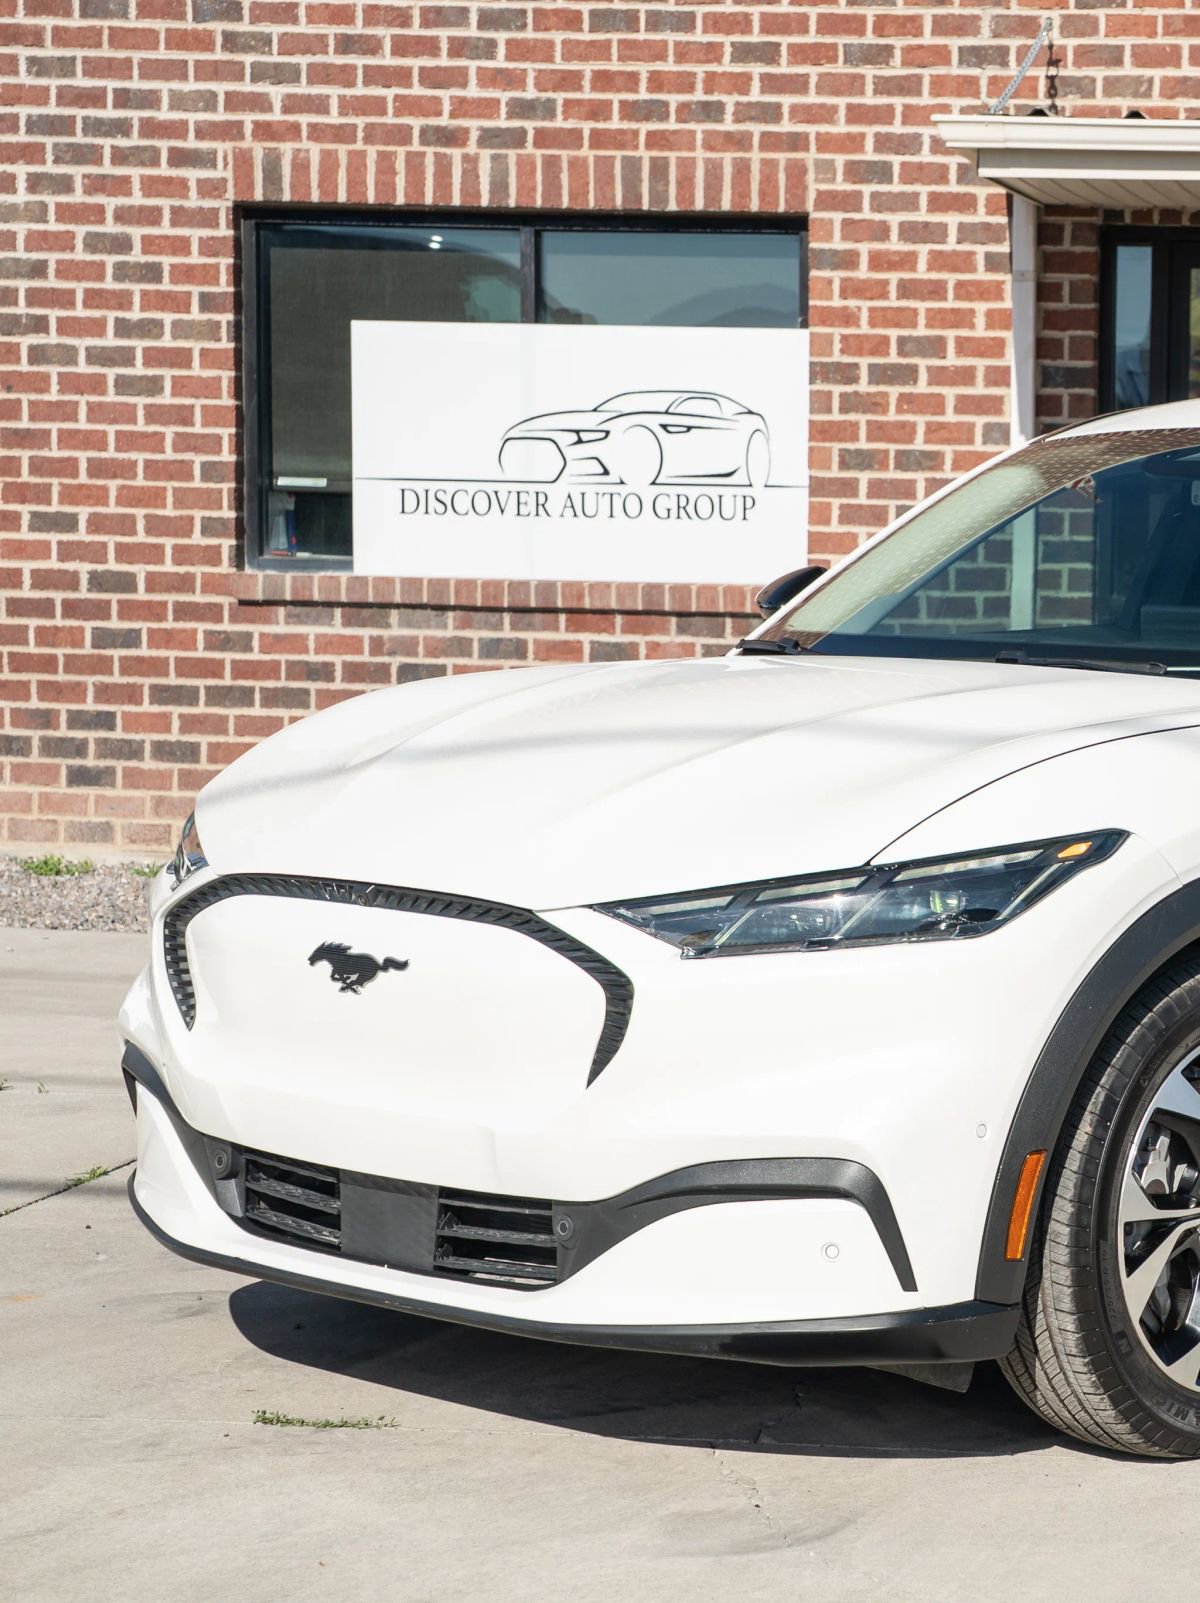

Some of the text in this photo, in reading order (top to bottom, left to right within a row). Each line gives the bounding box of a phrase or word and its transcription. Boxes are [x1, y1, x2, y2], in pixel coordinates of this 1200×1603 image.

[400, 487, 757, 521] DISCOVER AUTO GROUP
